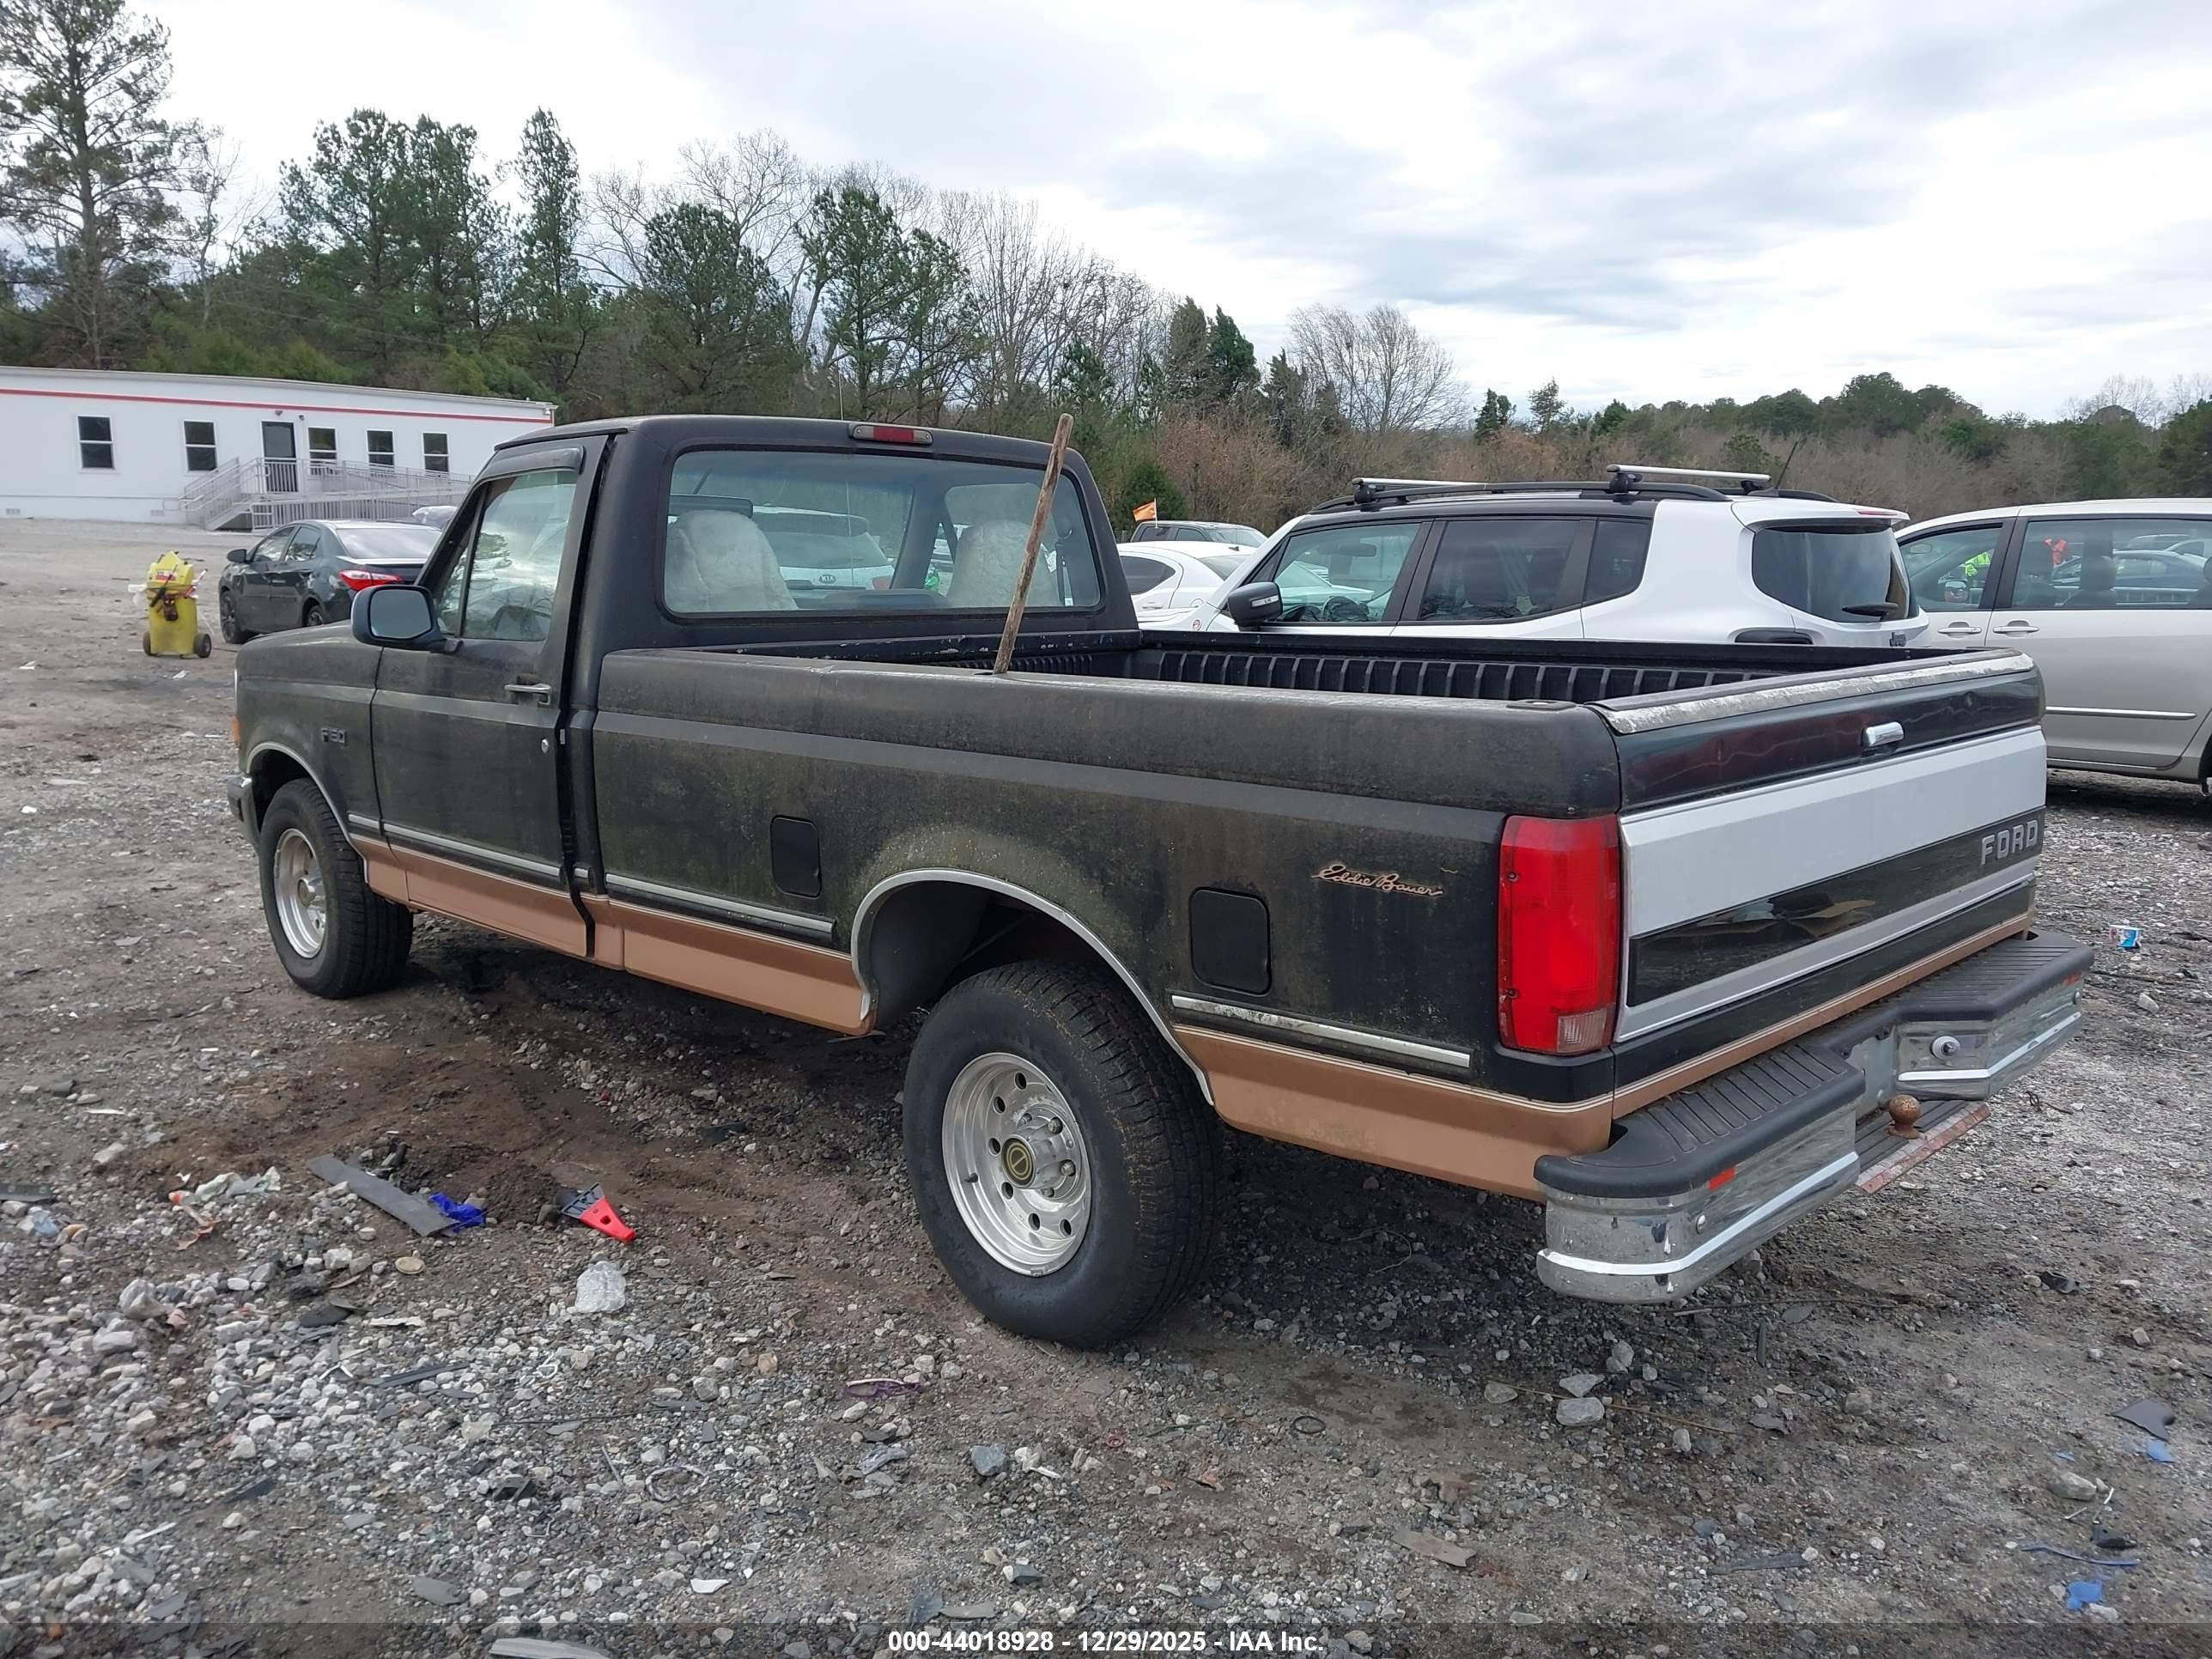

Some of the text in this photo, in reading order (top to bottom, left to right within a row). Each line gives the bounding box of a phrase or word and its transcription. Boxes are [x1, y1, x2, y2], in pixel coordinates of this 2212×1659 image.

[818, 574, 836, 584] KIA
[1980, 819, 2038, 866] FORD
[1311, 864, 1443, 896] Eddie Bauer
